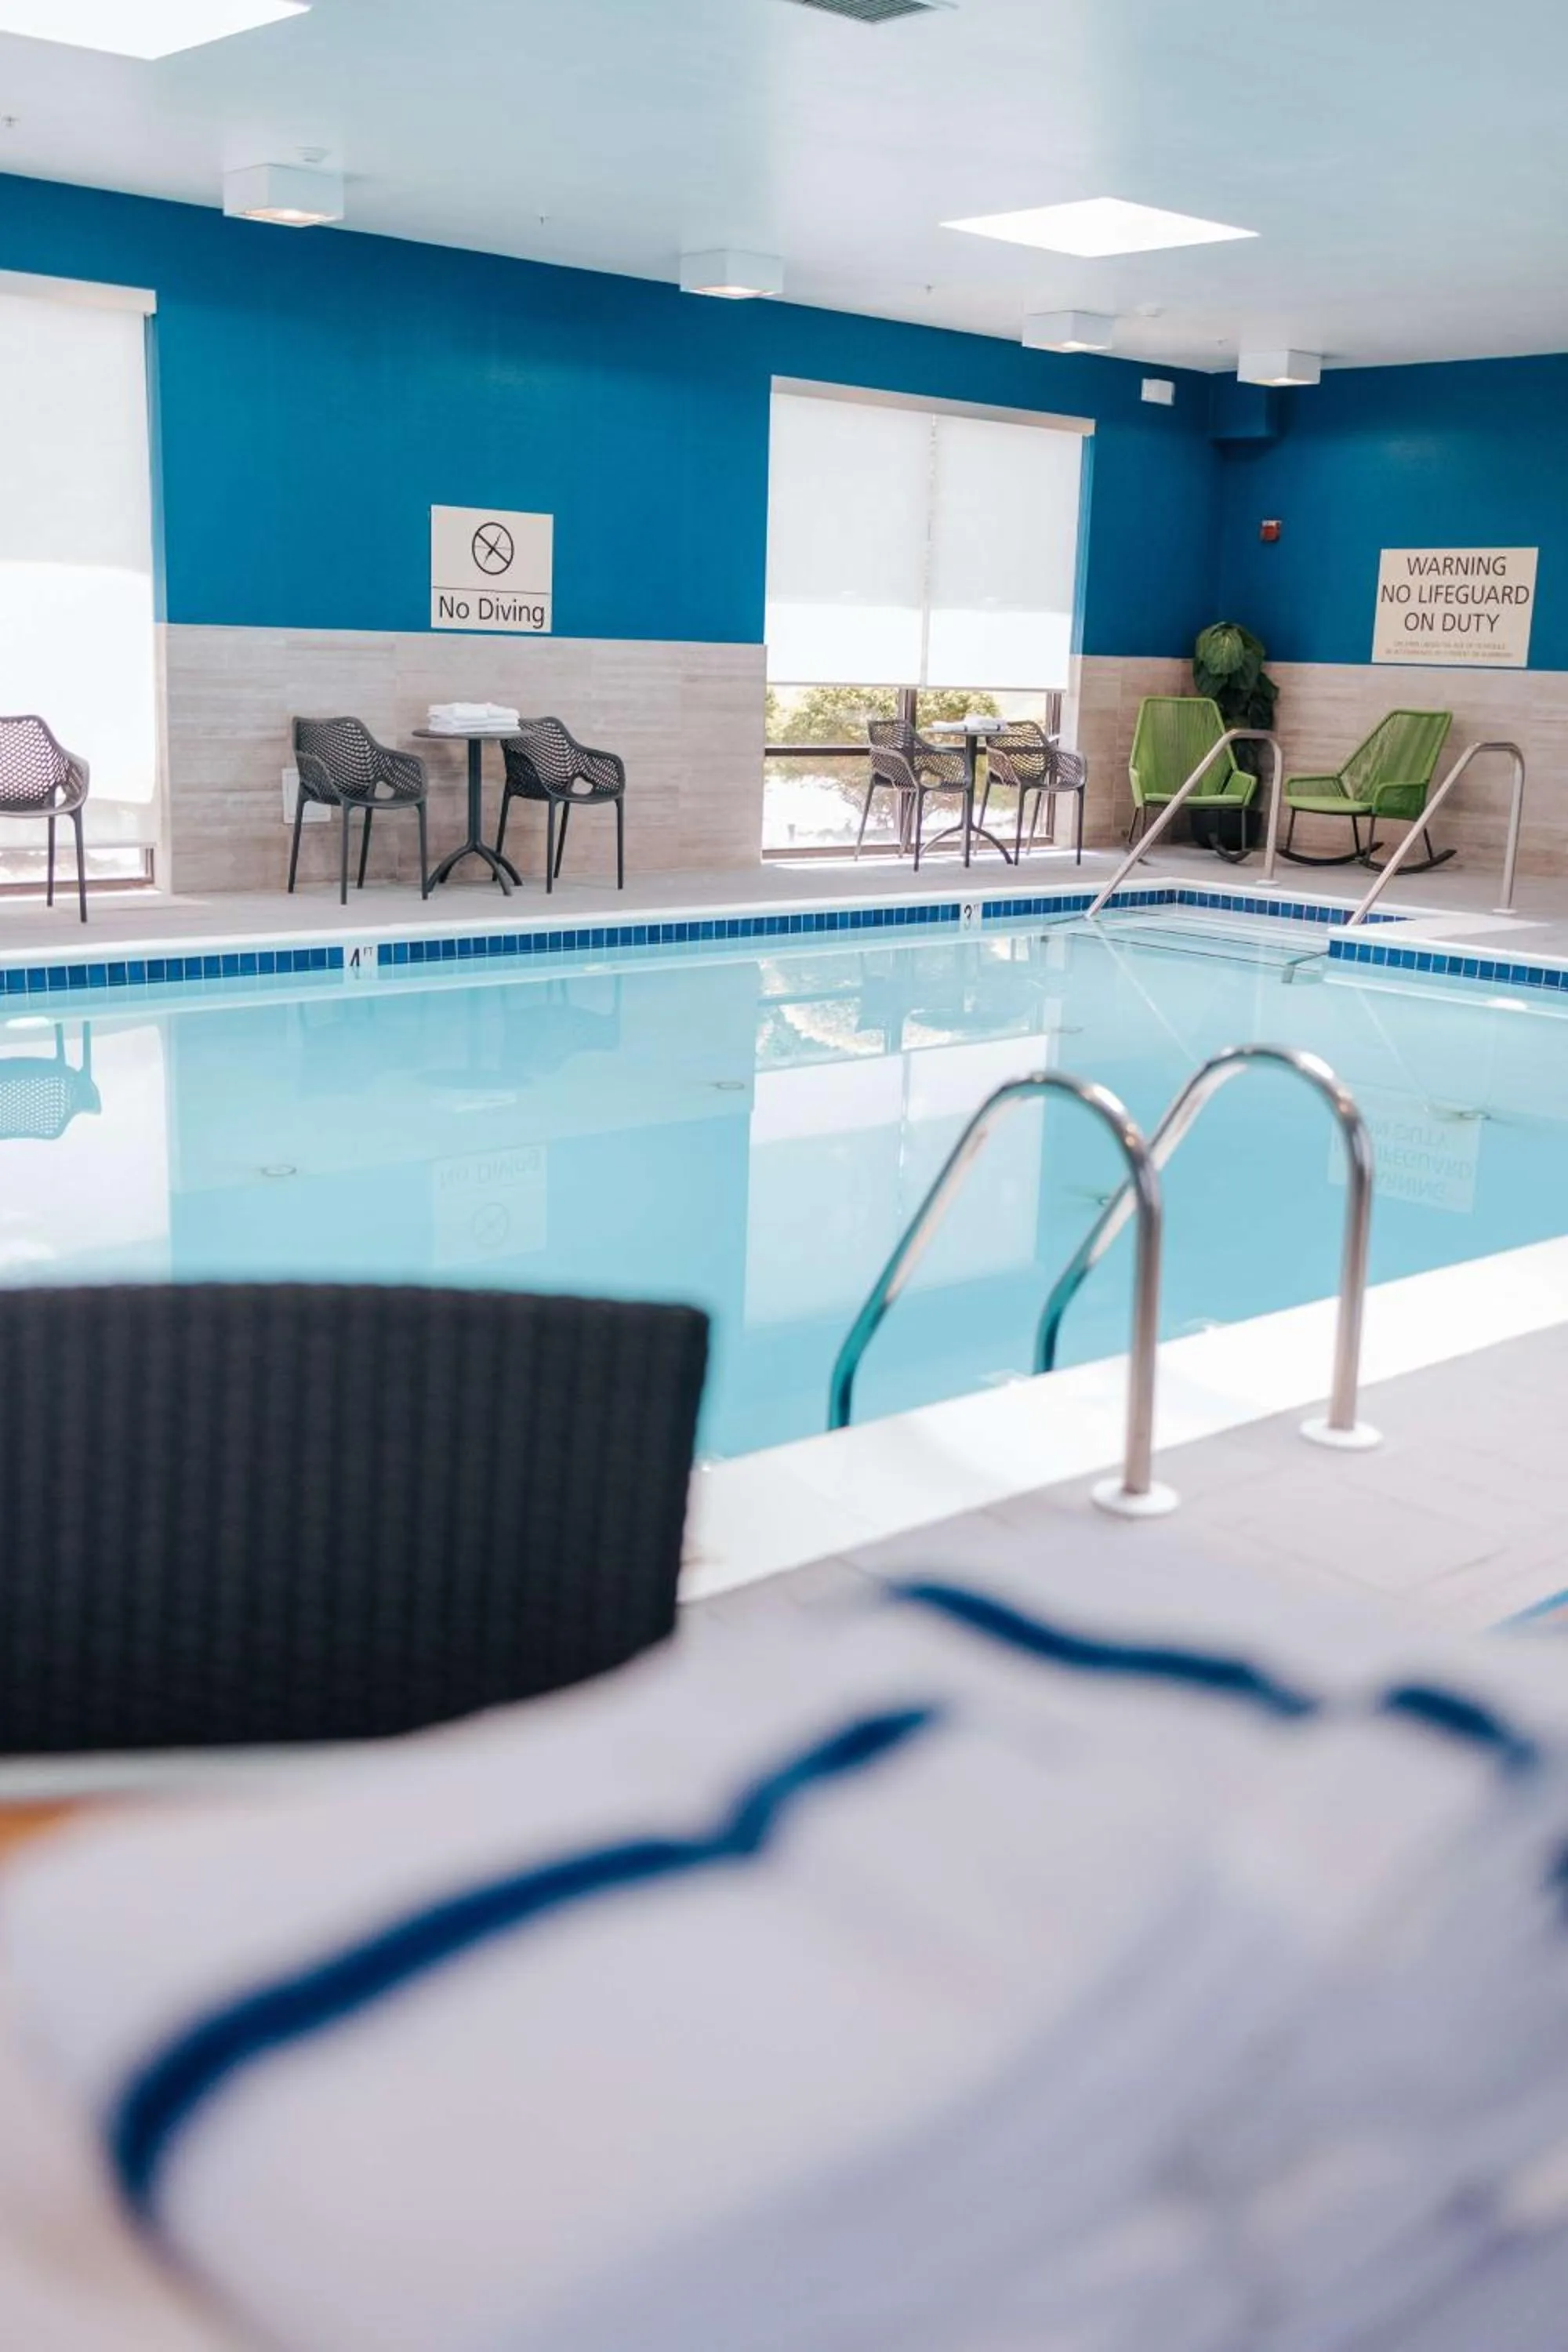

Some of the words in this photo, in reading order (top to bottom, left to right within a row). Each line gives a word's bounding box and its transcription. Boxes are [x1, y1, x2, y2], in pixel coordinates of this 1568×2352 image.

[1407, 556, 1507, 576] WARNING
[1381, 584, 1411, 603] NO
[1418, 584, 1530, 604] LIFEGUARD
[439, 596, 470, 619] No
[479, 597, 544, 630] Diving
[1404, 612, 1435, 631] ON
[1443, 613, 1500, 633] DUTY
